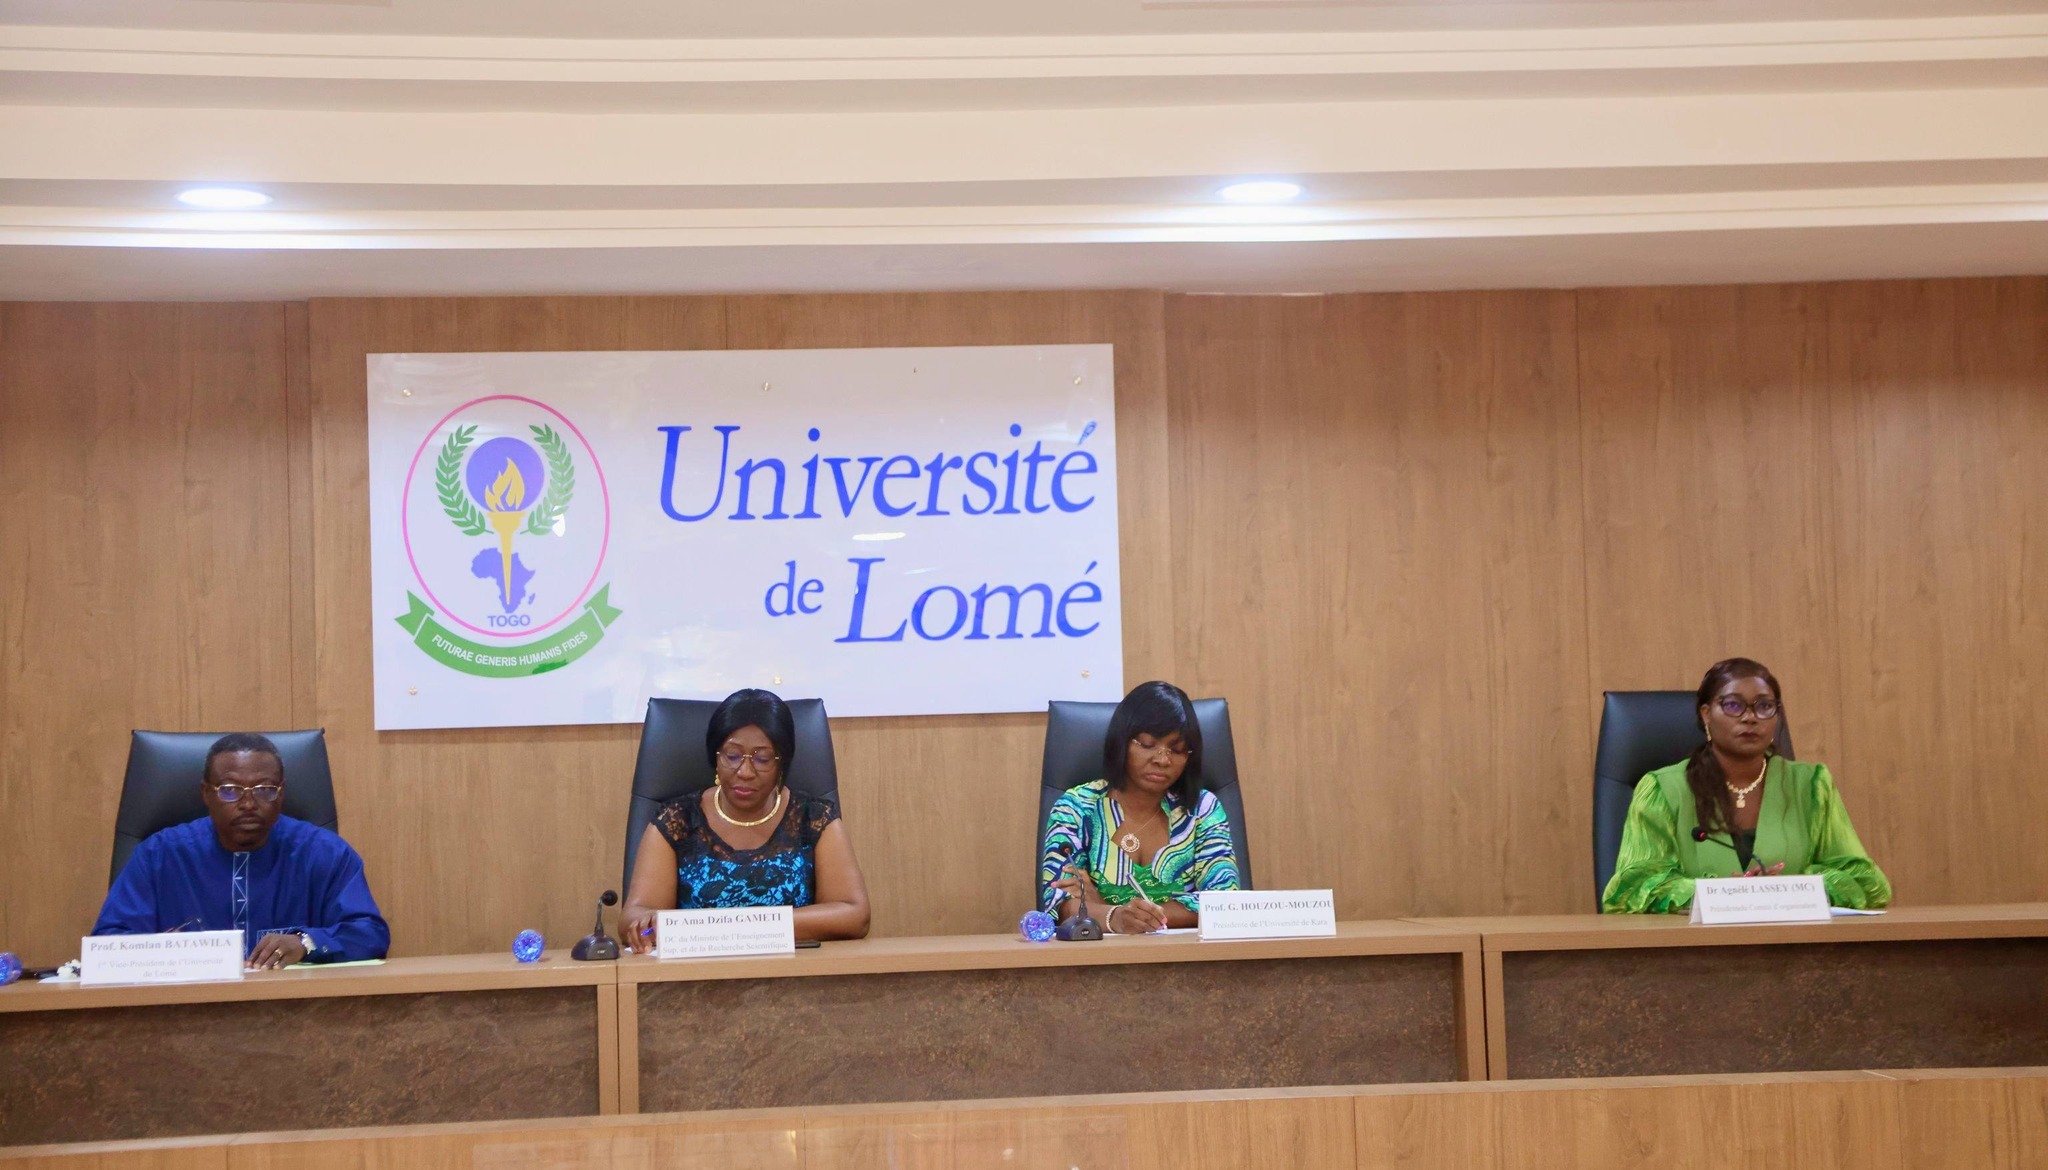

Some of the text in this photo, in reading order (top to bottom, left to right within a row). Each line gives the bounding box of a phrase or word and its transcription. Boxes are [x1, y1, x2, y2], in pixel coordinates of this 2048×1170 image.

[657, 420, 1098, 522] Université
[764, 558, 1103, 643] de Lomé
[487, 614, 531, 628] TOGO
[431, 631, 589, 667] FUTURAE GENERIS HUMANIS FIDES
[1706, 886, 1718, 895] Dr
[1751, 883, 1789, 894] LASSEY
[1791, 882, 1816, 893] (MC)
[1204, 903, 1226, 912] Prof.
[1227, 902, 1239, 911] G.
[665, 912, 781, 926] Dr Ama Dzifa GAMETI
[90, 938, 231, 952] Prof. Komlan BATAWILA
[664, 935, 676, 944] DC
[678, 935, 688, 943] du
[689, 934, 719, 943] Ministre
[720, 933, 730, 941] de
[689, 945, 698, 953] de
[699, 944, 706, 953] la
[707, 943, 745, 953] Recherche
